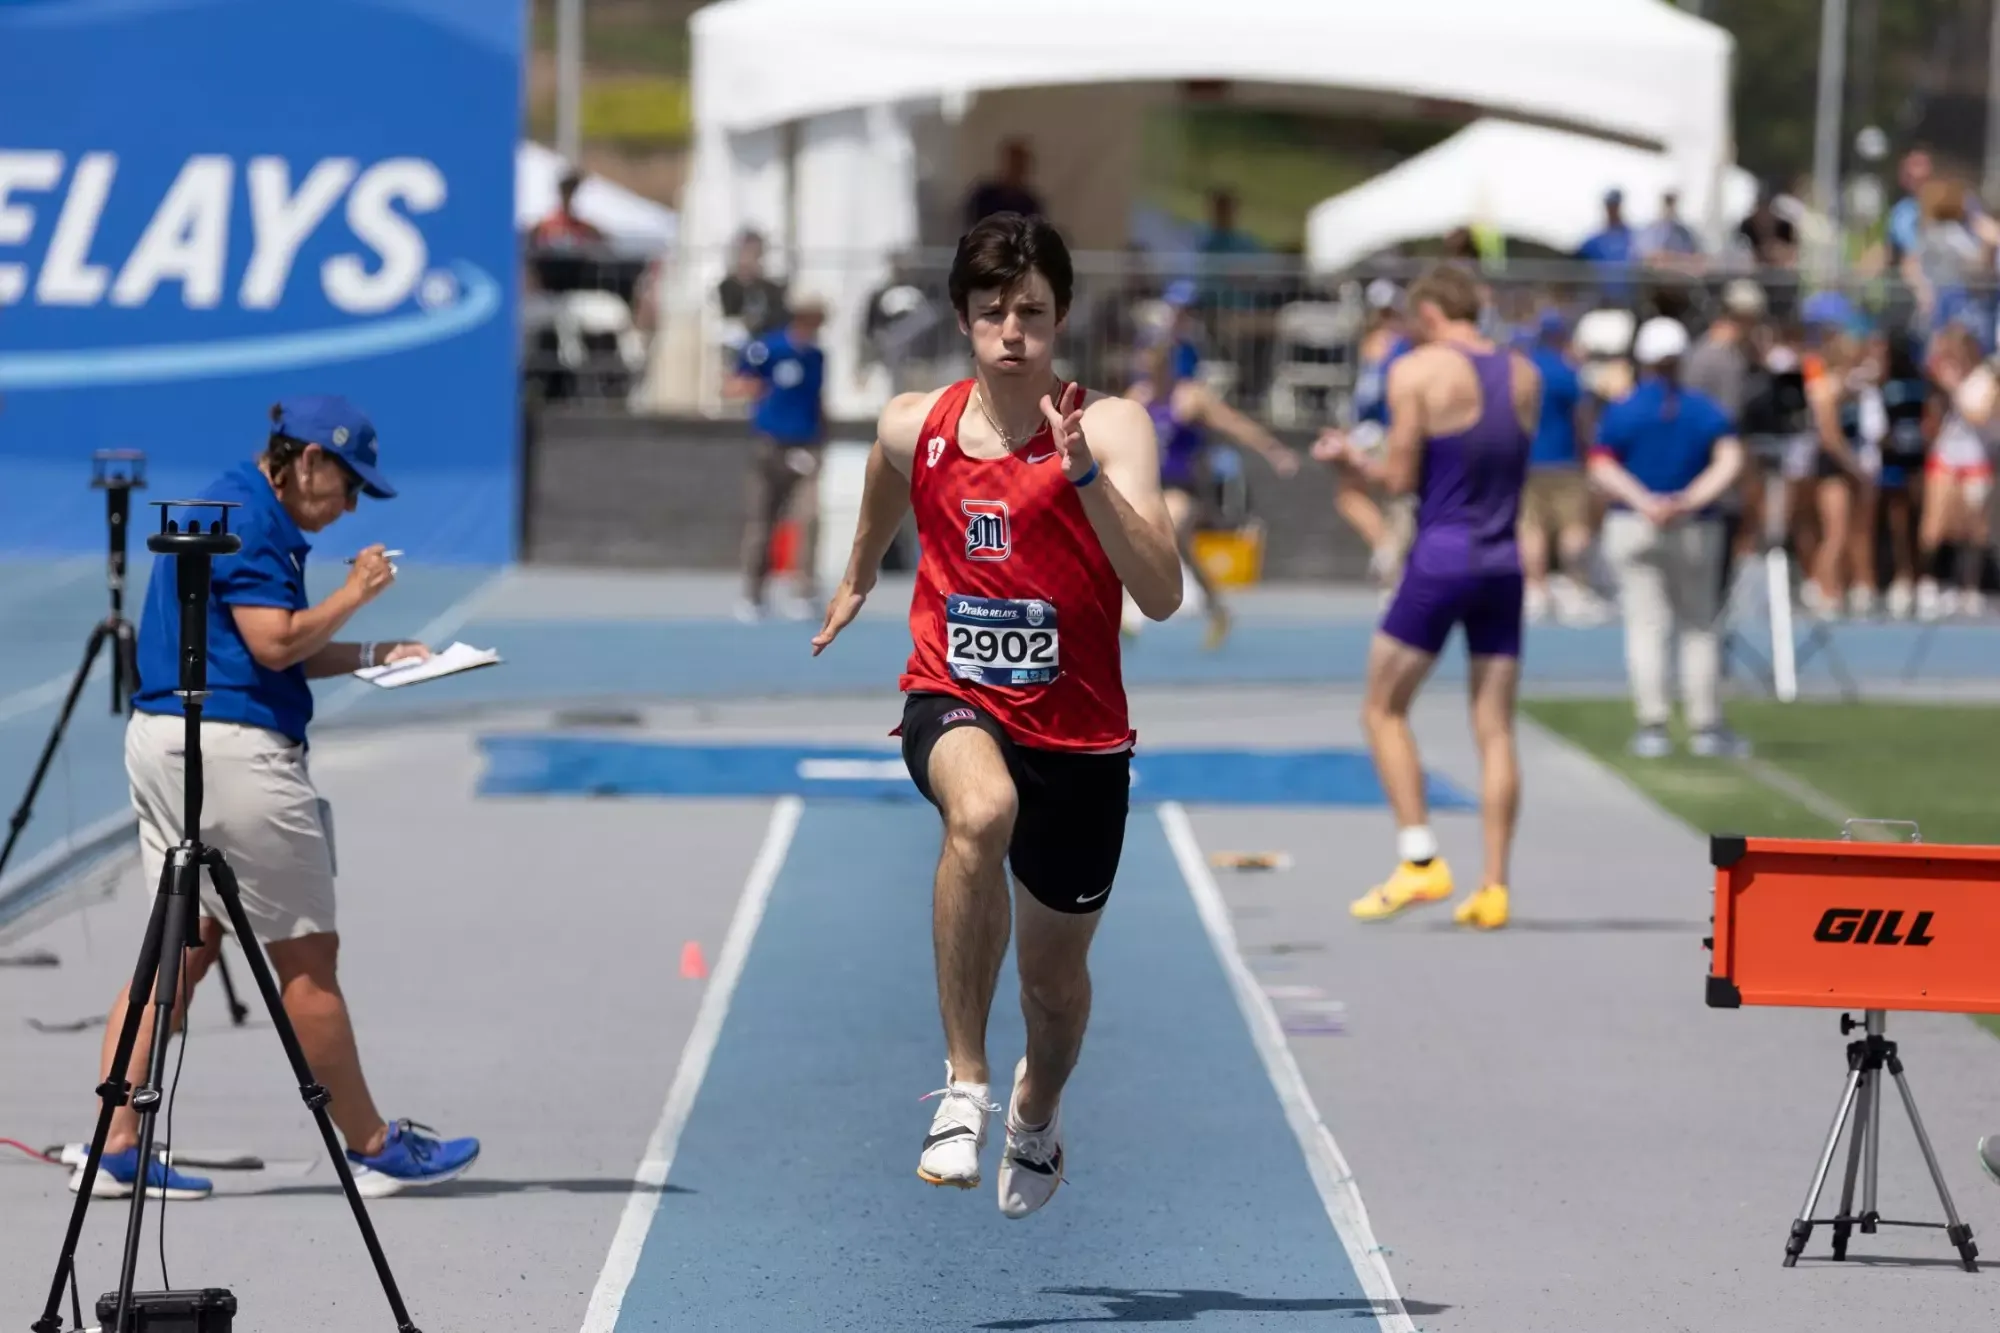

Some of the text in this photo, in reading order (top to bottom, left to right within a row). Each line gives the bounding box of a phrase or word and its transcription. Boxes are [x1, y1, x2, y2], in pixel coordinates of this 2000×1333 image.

[957, 601, 1018, 618] Drake RELAYS
[953, 627, 1054, 663] 2902
[1813, 907, 1936, 947] GILL
